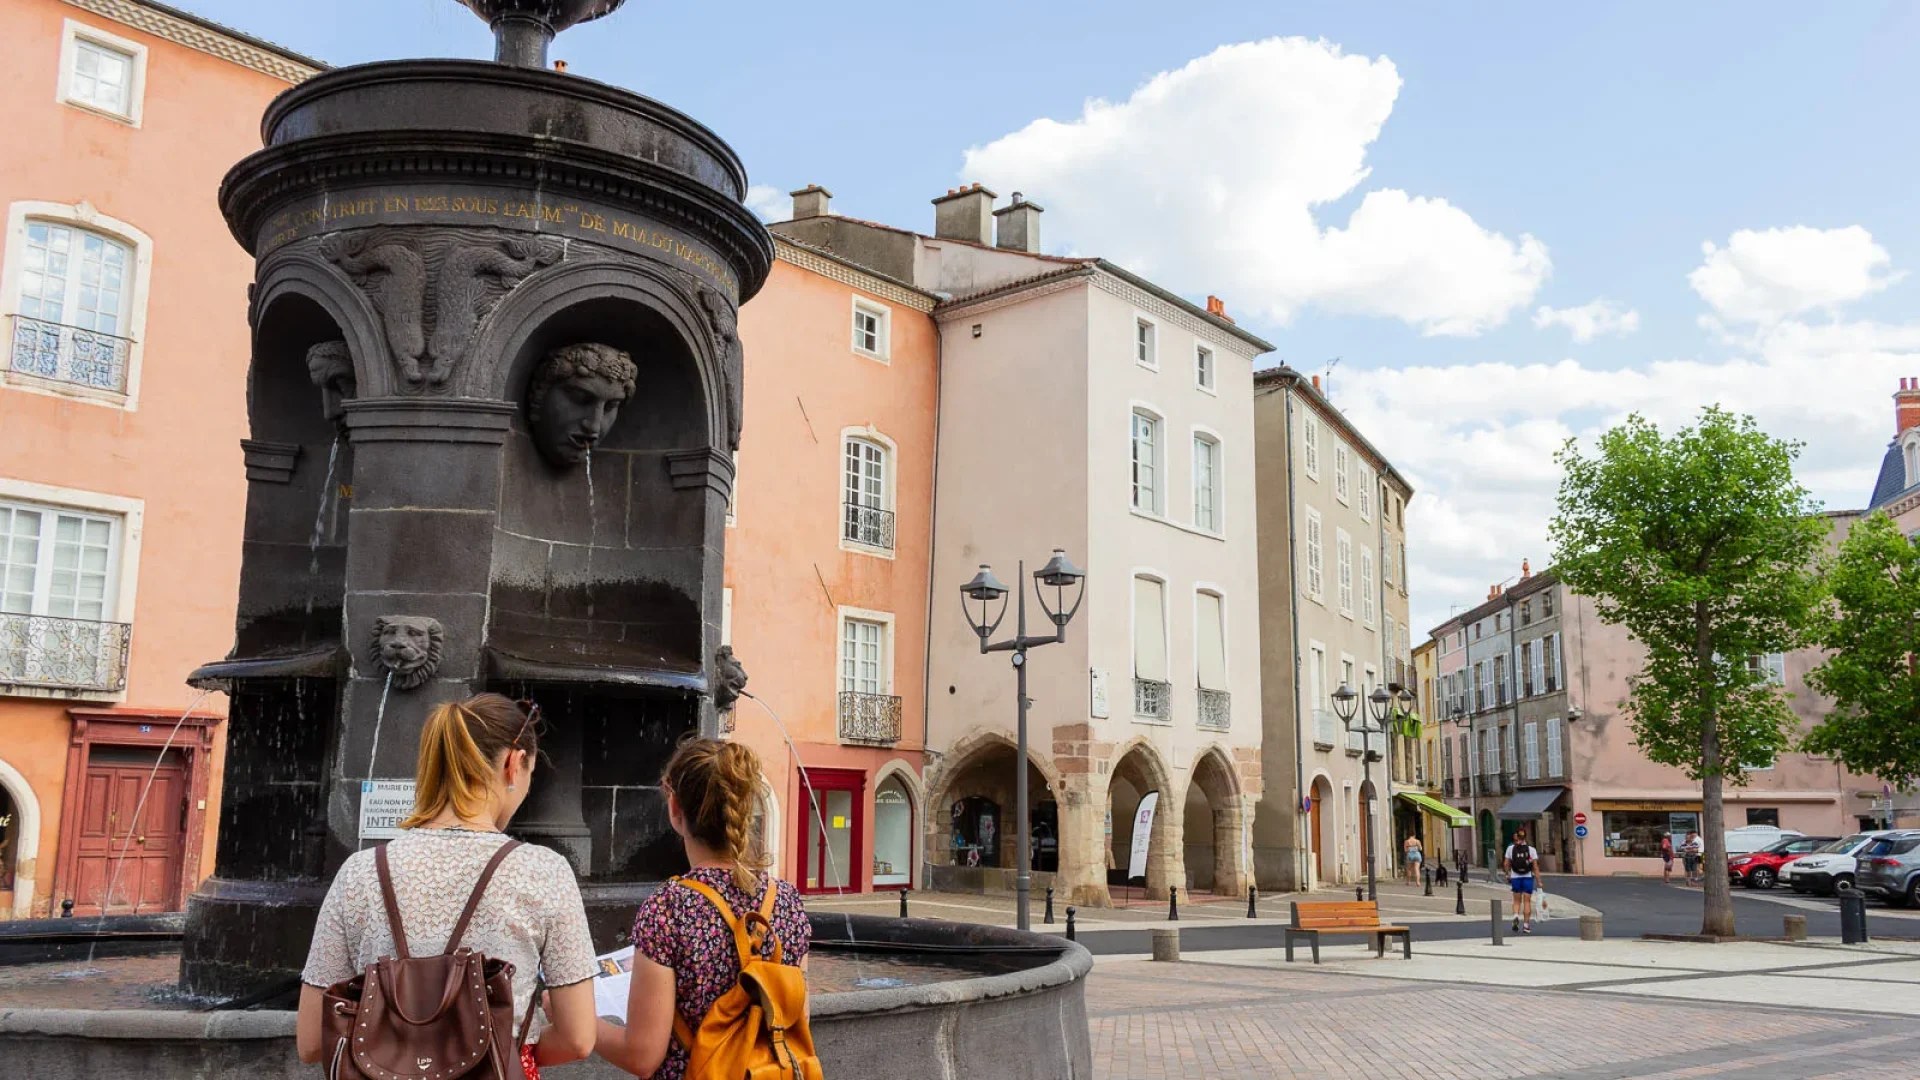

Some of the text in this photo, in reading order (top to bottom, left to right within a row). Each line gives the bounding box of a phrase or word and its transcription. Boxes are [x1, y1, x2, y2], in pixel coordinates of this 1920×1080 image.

[383, 197, 409, 212] EN
[452, 197, 498, 214] SOUS
[580, 210, 607, 232] DE
